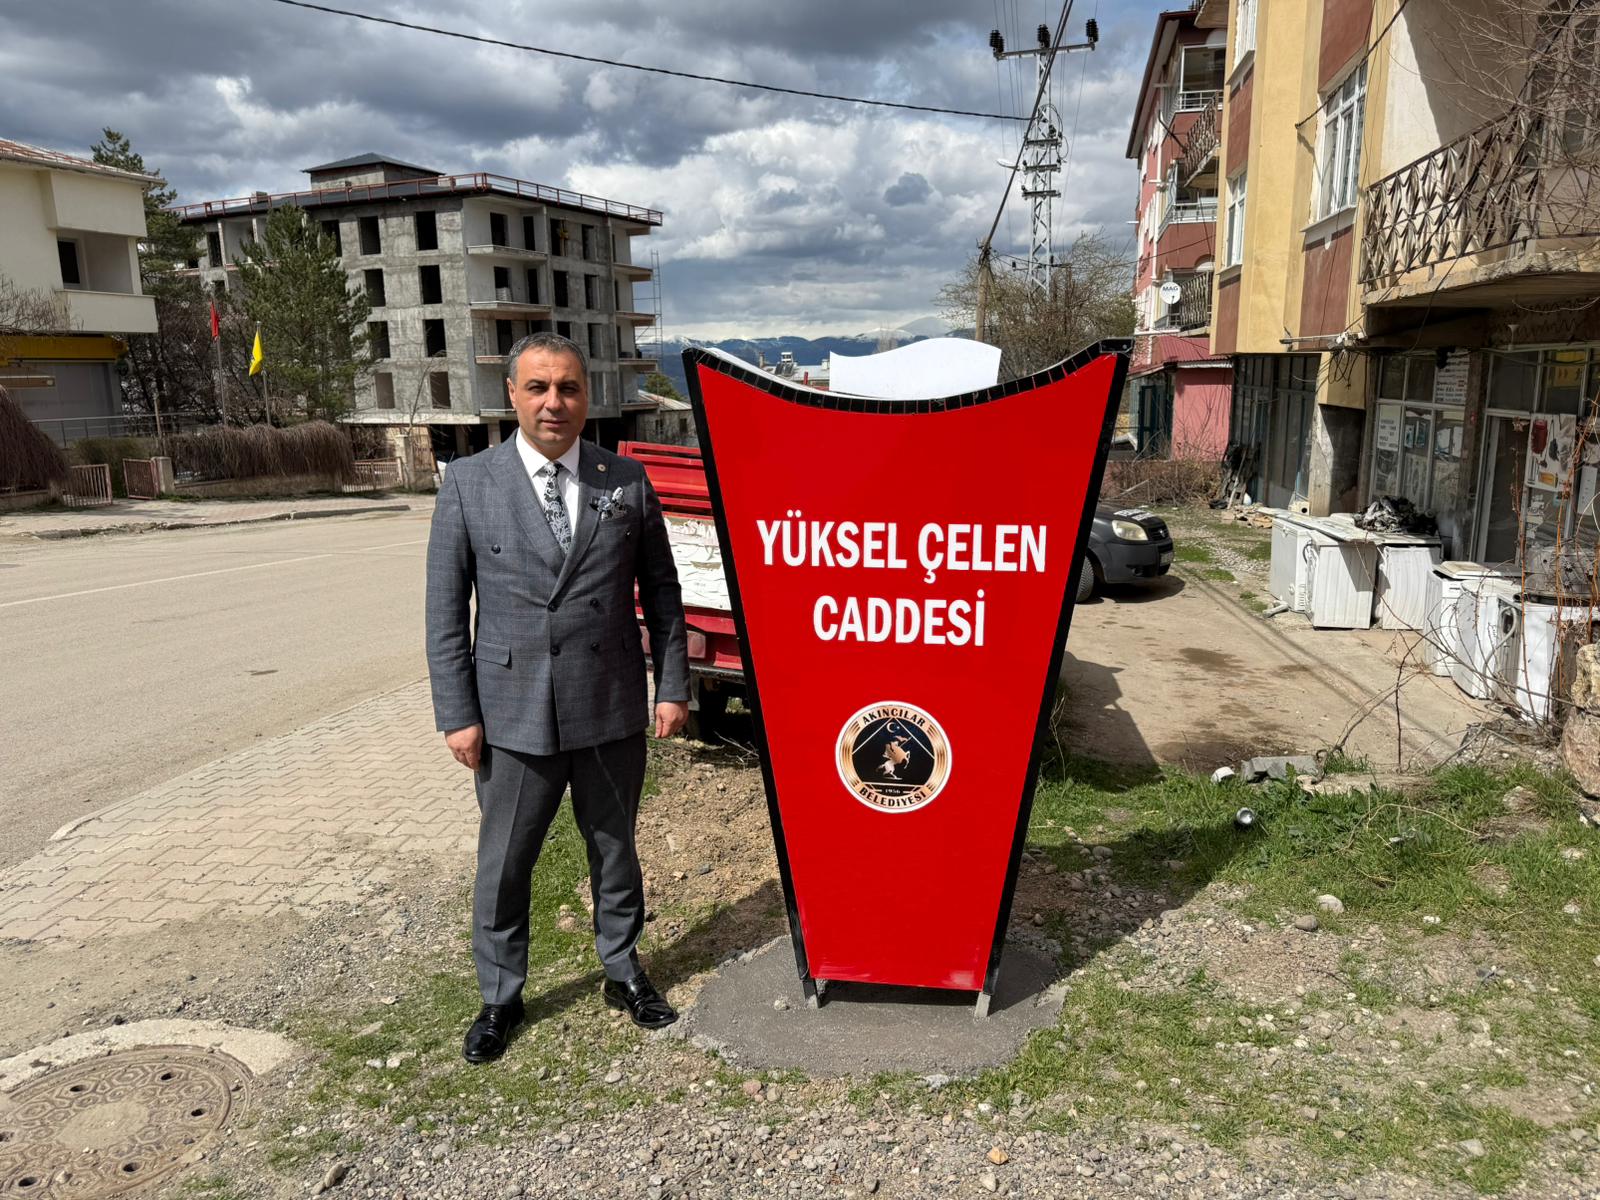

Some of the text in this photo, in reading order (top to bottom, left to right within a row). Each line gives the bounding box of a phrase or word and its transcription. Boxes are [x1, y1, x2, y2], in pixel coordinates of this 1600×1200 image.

[757, 510, 1046, 584] YÜKSEL ÇELEN
[814, 589, 984, 646] CADDESİ
[863, 708, 926, 727] AKINCILAR
